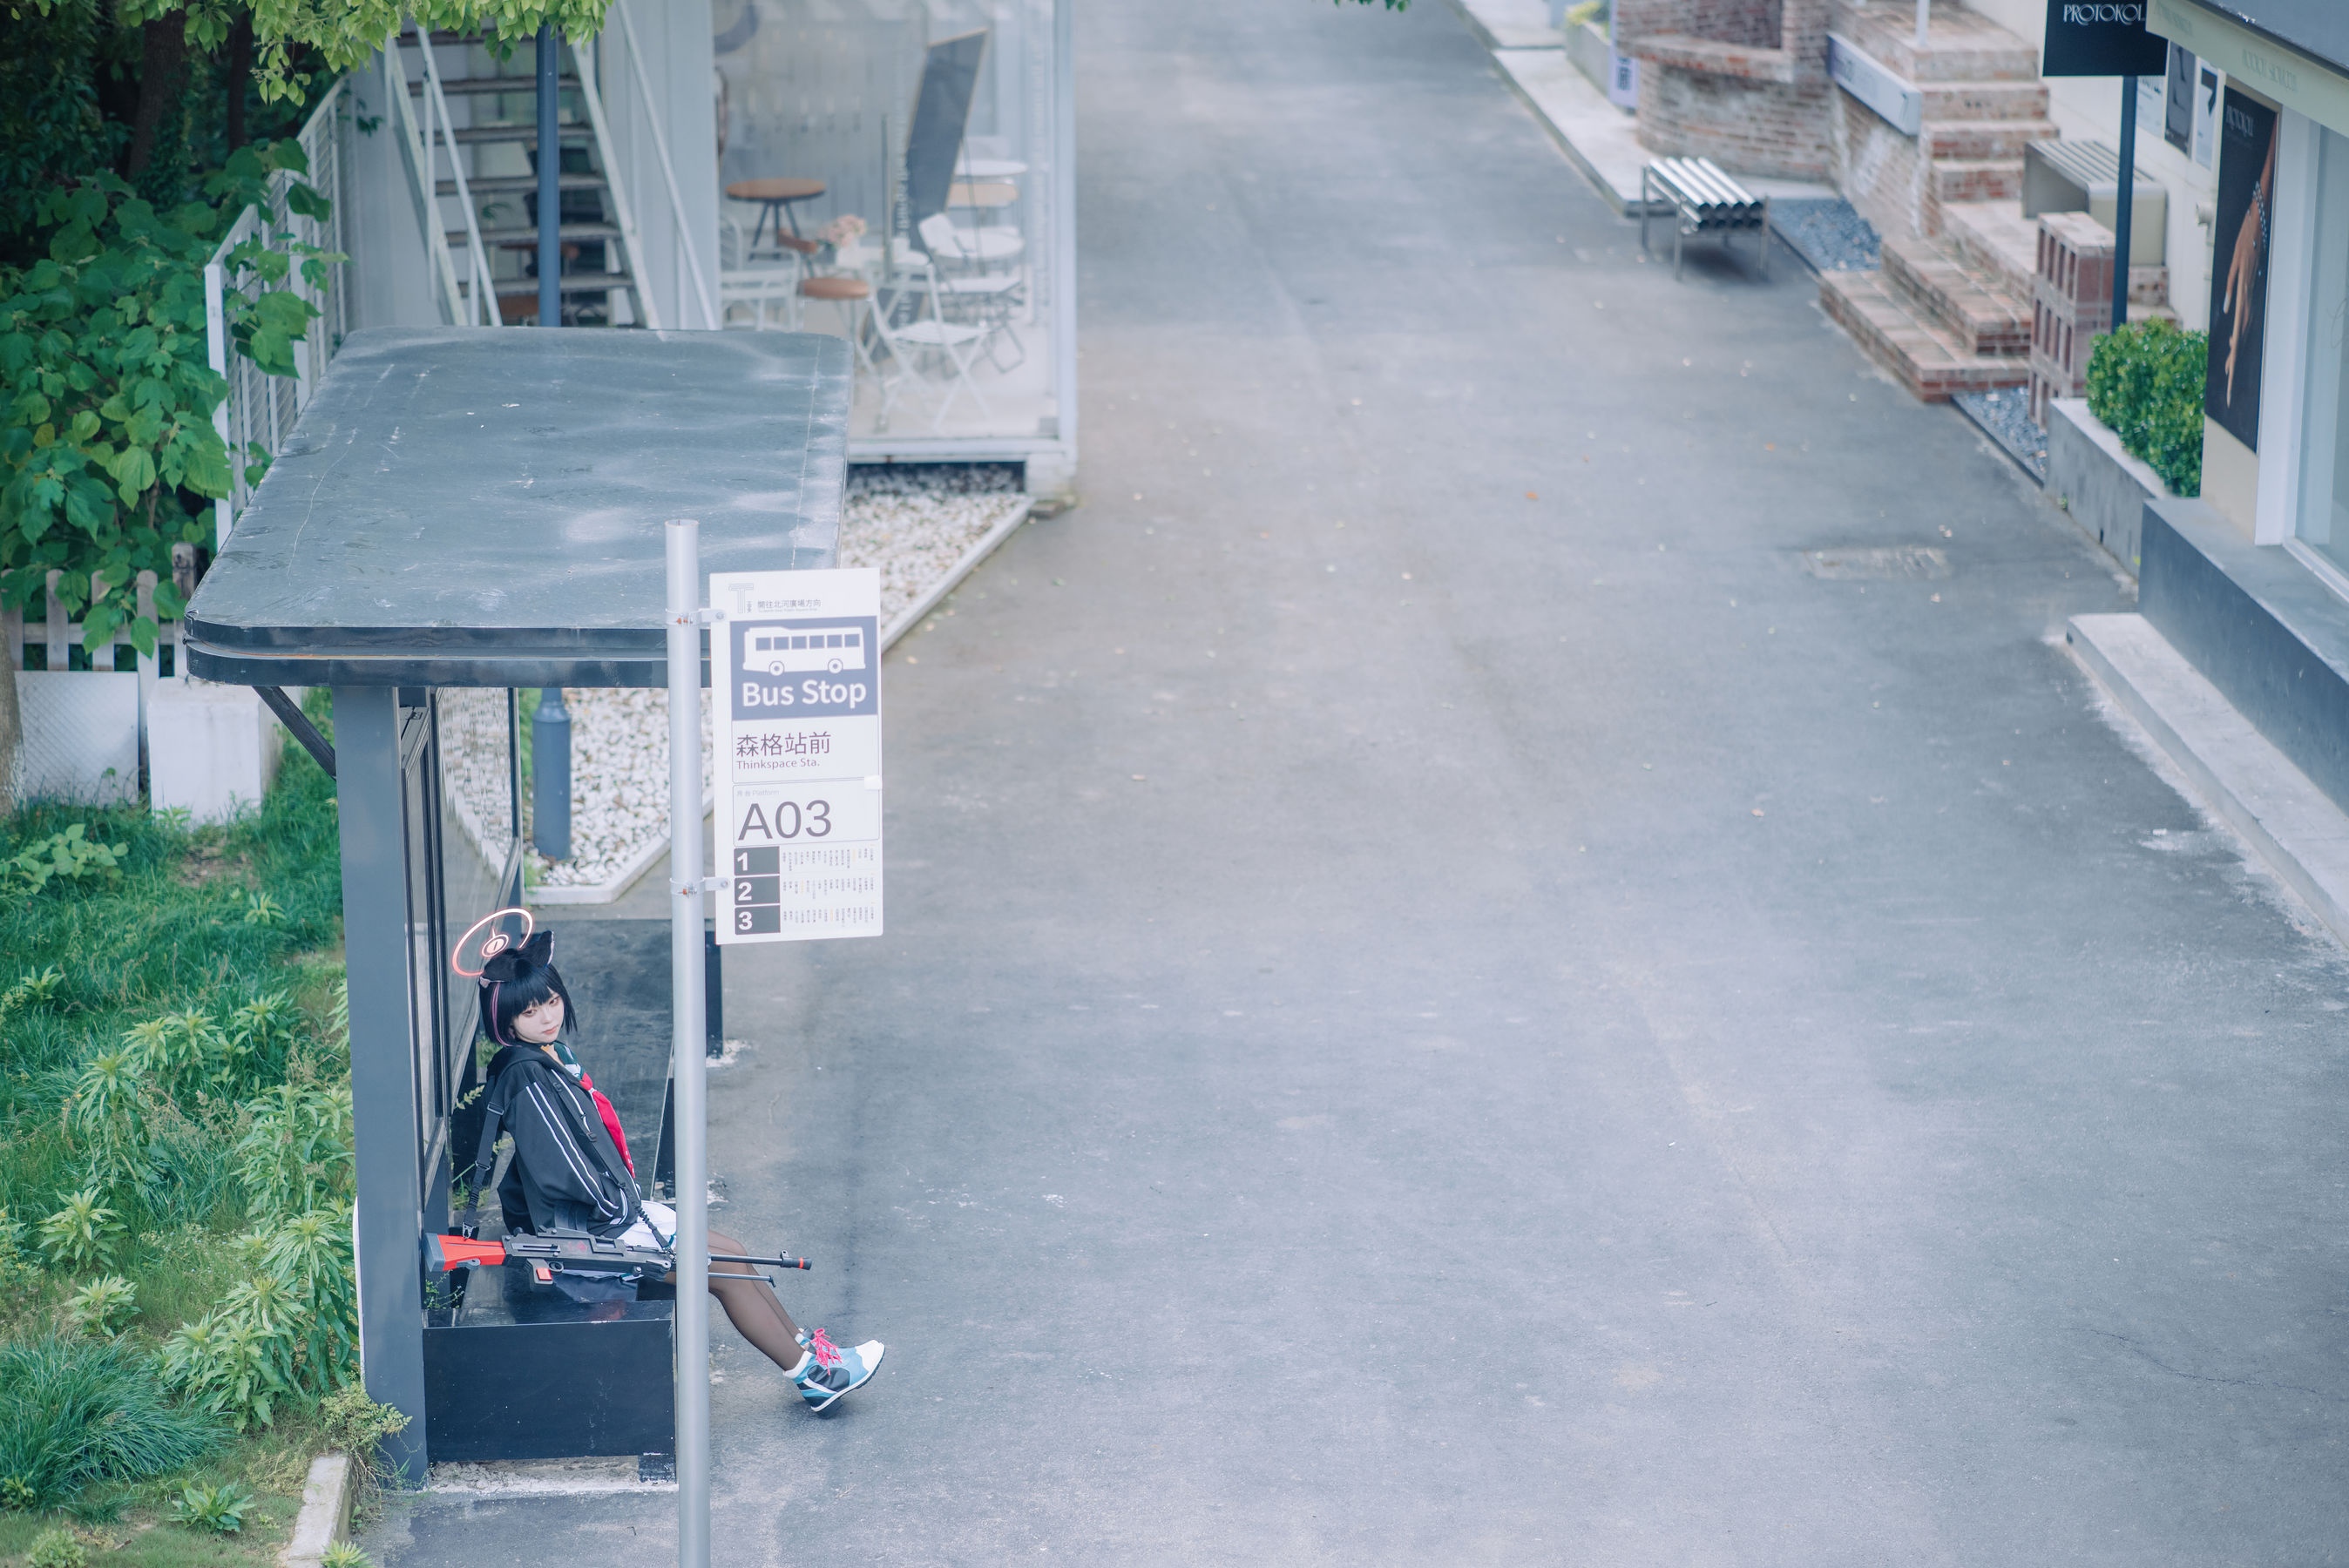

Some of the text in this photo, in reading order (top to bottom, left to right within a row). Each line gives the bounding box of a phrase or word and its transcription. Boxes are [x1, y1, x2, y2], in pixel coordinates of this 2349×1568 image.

[742, 679, 867, 709] Bus Stop
[736, 732, 831, 757] 森格站前
[736, 759, 821, 770] Thinkspace Sta.
[738, 800, 831, 841] A03
[737, 852, 748, 871] 1
[738, 882, 752, 902] 2
[738, 911, 753, 930] 3
